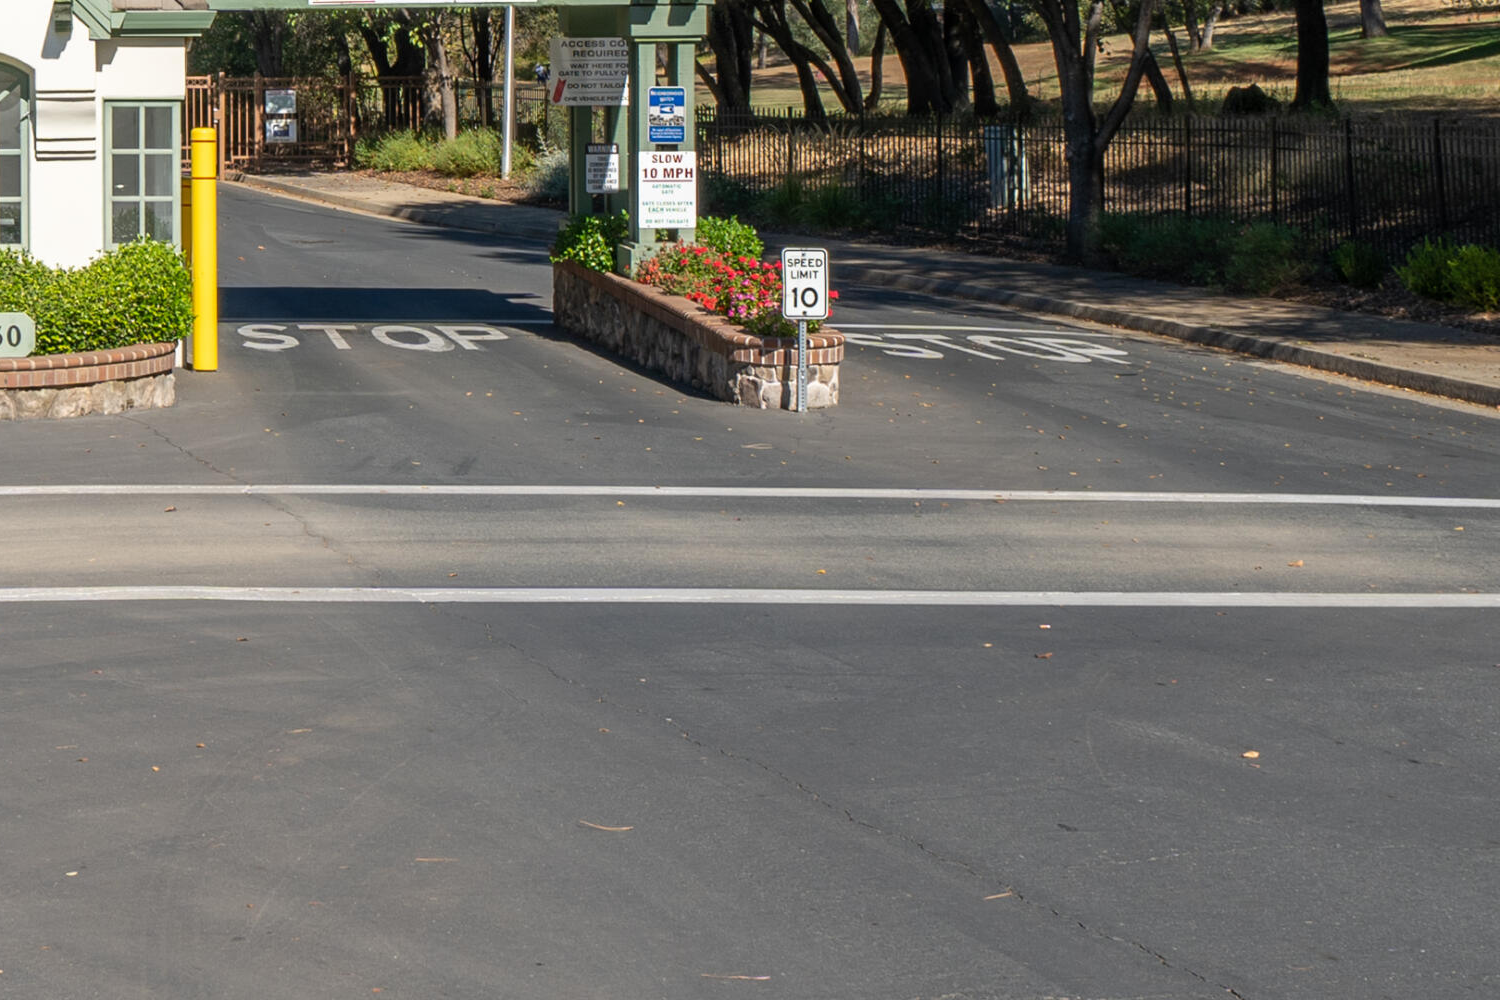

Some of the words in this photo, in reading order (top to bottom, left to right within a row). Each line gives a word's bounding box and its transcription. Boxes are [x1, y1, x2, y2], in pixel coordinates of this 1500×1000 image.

[561, 40, 605, 48] ACCESS
[572, 49, 629, 58] REQUIRED
[652, 154, 683, 163] SLOW
[643, 168, 658, 178] 10
[663, 168, 693, 178] MPH
[787, 258, 823, 268] SPEED
[790, 270, 819, 279] LIMIT
[792, 287, 819, 308] 10
[237, 323, 509, 352] STOP
